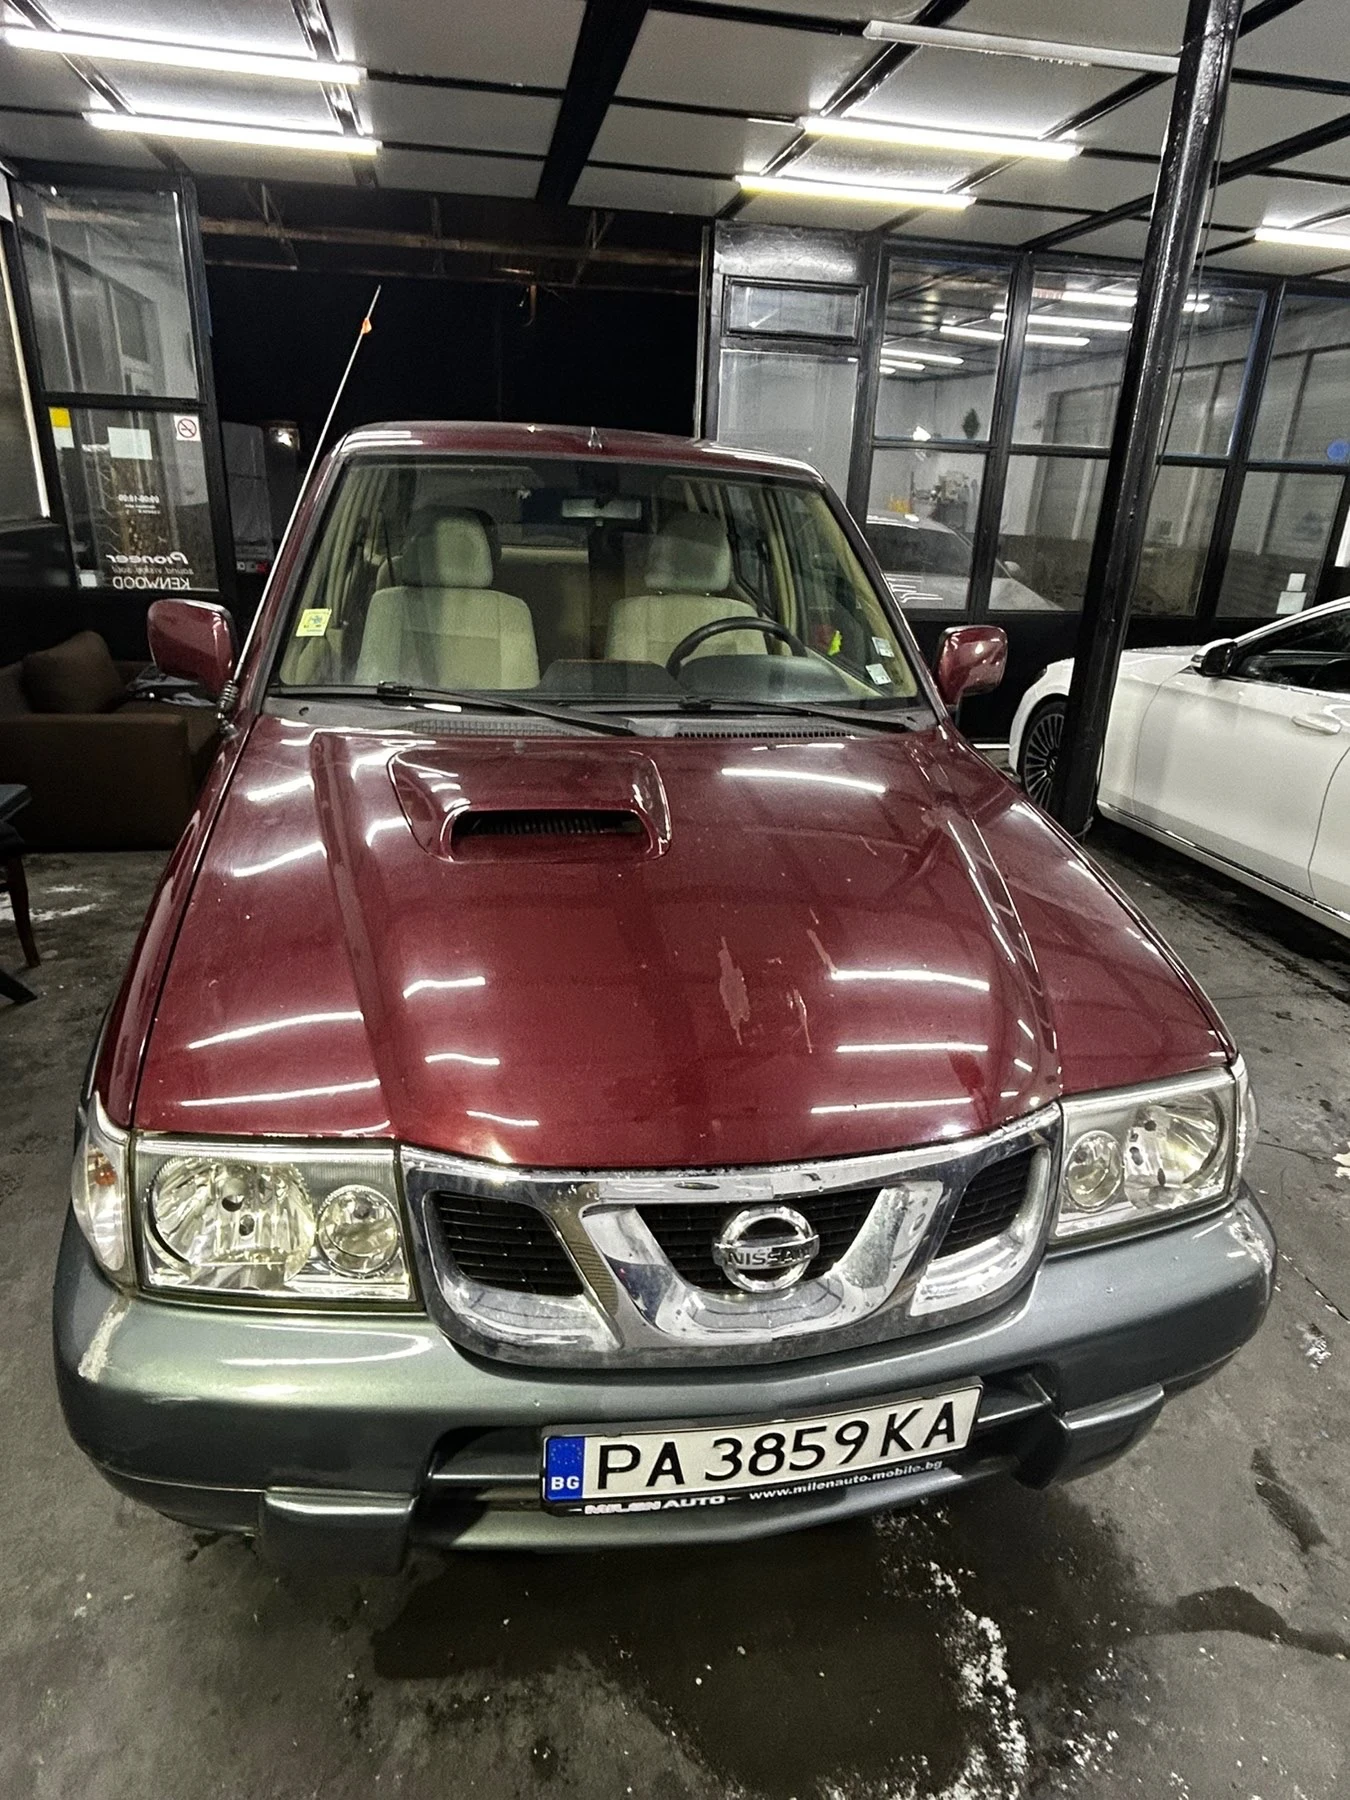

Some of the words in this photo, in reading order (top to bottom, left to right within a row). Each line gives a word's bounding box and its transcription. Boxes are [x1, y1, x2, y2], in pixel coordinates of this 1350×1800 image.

[597, 1441, 685, 1490] PA
[704, 1420, 870, 1481] 3859
[879, 1401, 957, 1457] KA
[551, 1475, 580, 1491] BG
[661, 1495, 725, 1509] AUTO
[749, 1460, 942, 1500] www.milenauto.mobile.bg
